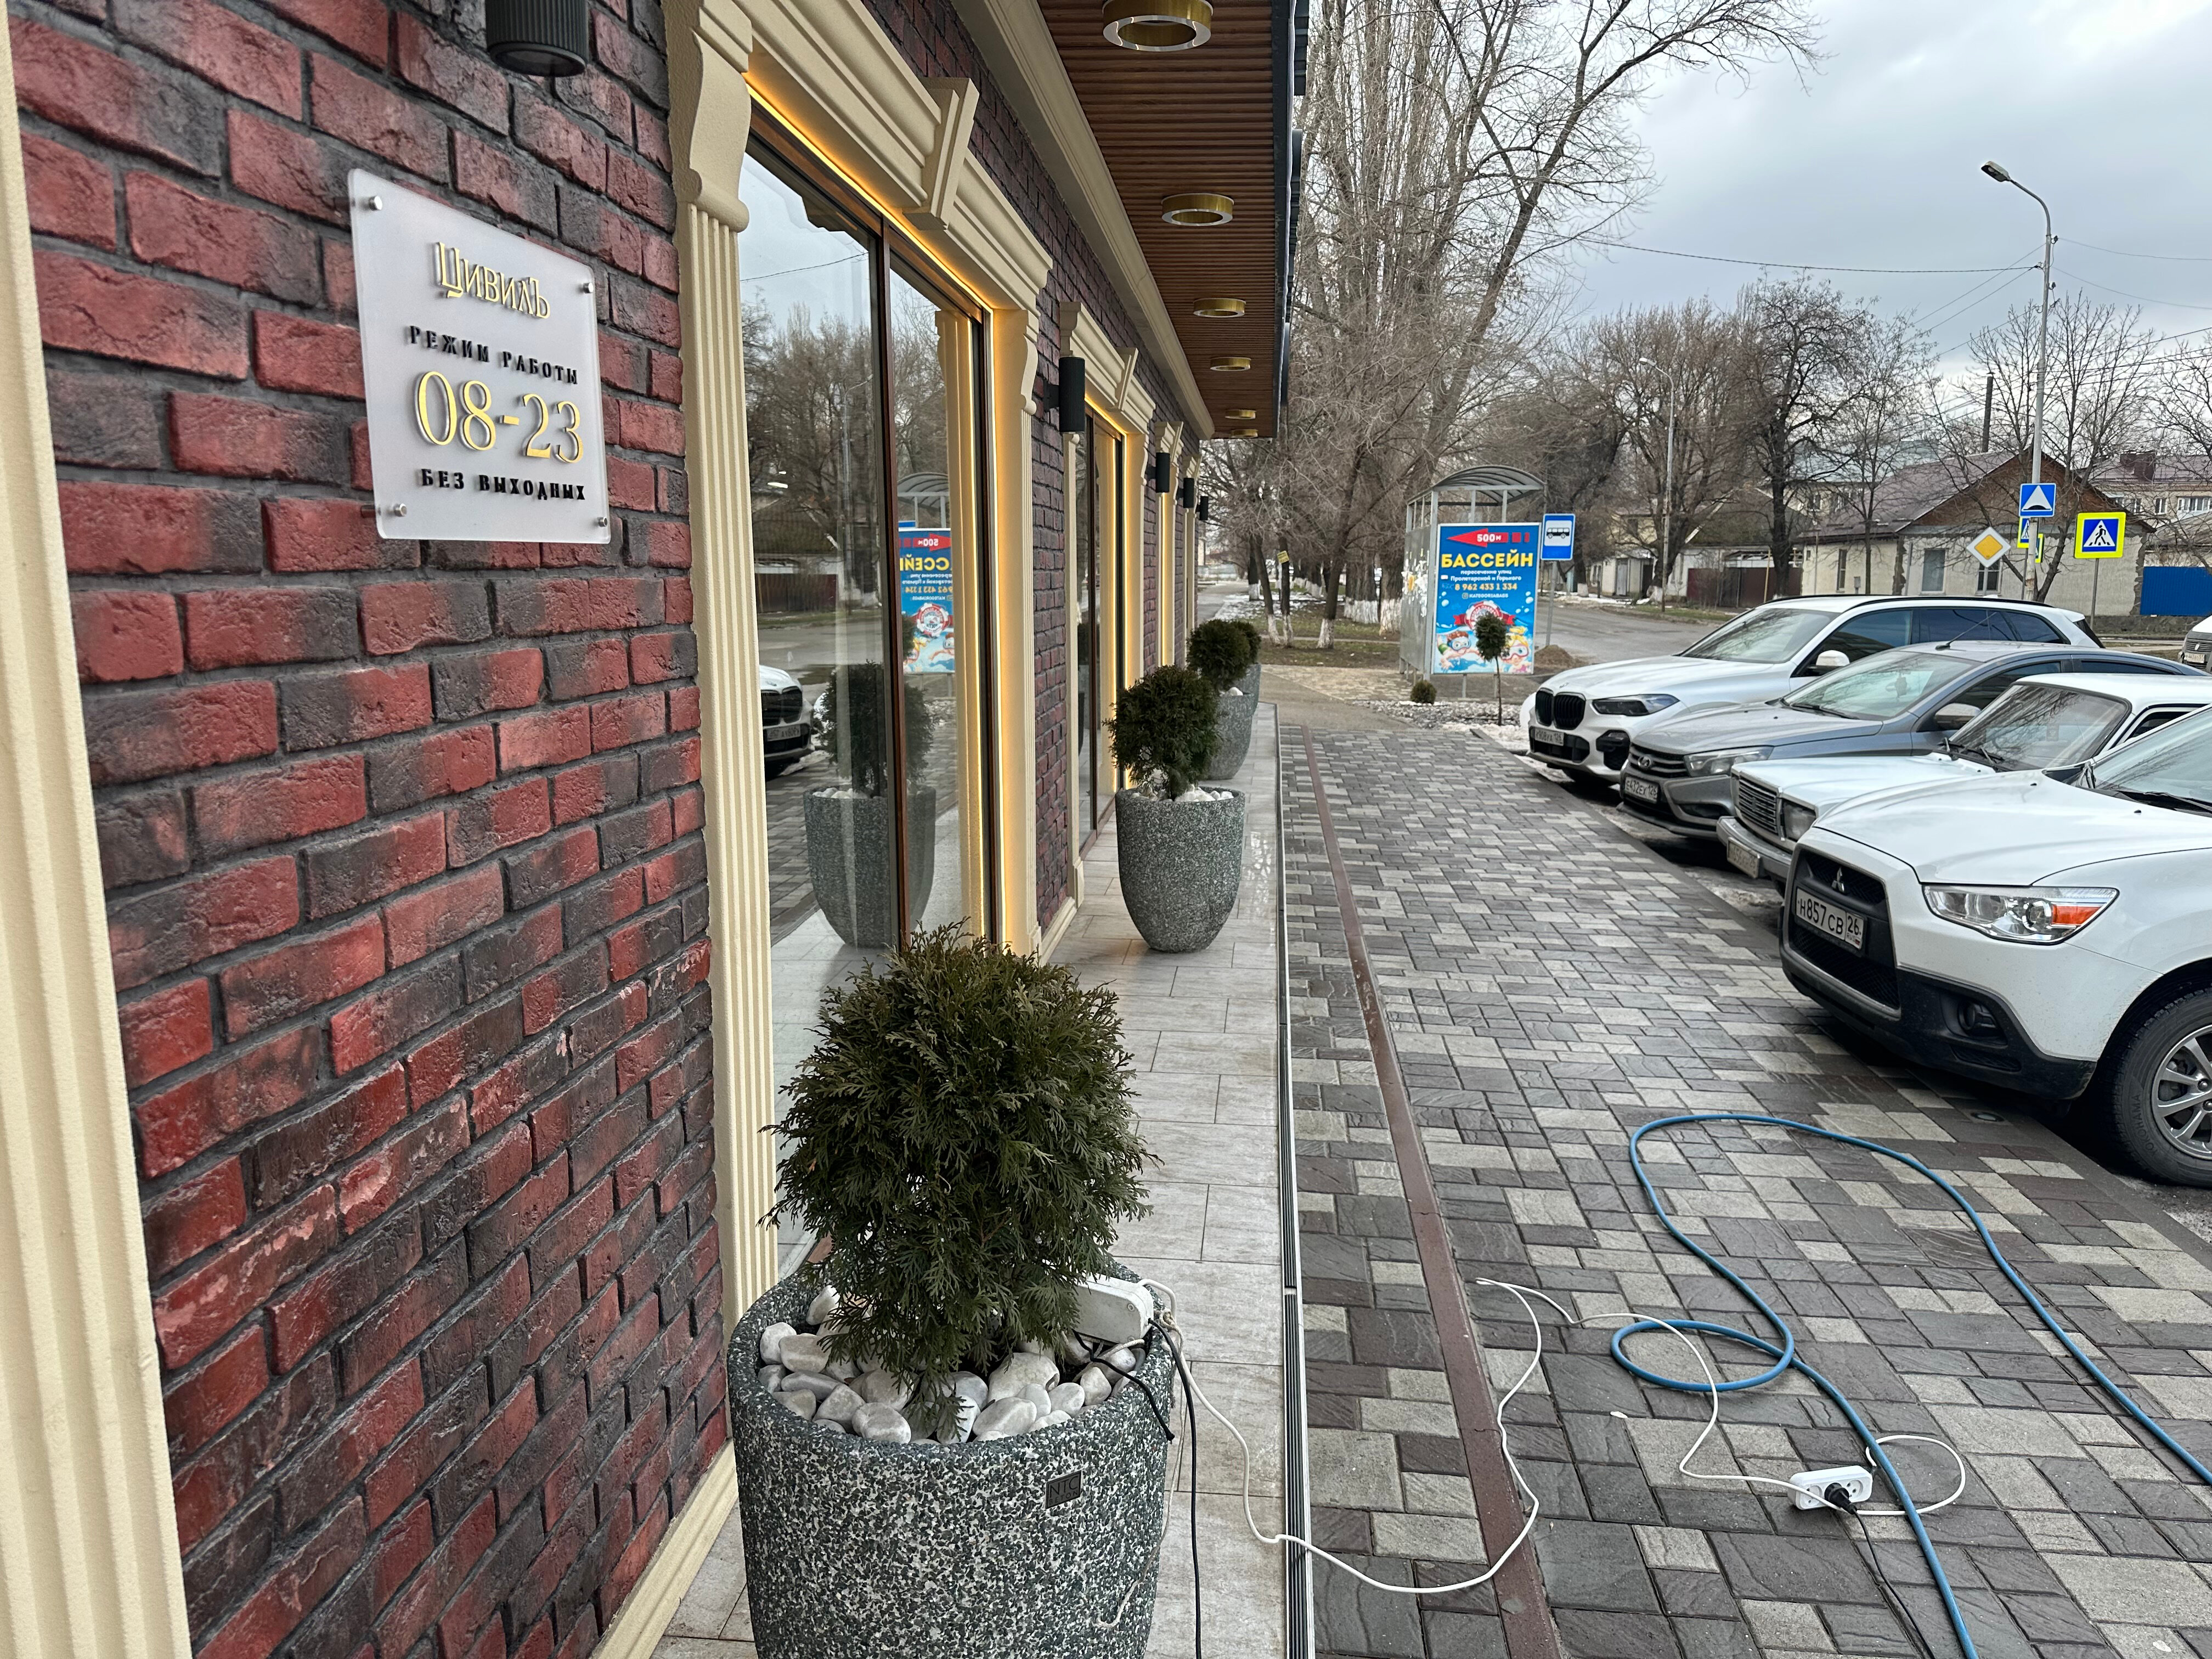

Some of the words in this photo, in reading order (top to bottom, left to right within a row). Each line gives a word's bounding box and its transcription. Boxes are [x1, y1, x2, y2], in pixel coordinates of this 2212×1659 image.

[410, 325, 490, 363] РЕЖИМ
[503, 351, 578, 385] РАБОТЫ
[415, 371, 584, 464] 08-23
[421, 469, 465, 489] БЕЗ
[478, 475, 585, 500] ВЫХОДНЫХ
[1441, 549, 1533, 568] БАССЕЙН
[1800, 898, 1844, 935] Н857СВ
[1847, 916, 1860, 935] 26
[2131, 1094, 2158, 1156] YOKOHAMA
[1049, 1476, 1079, 1498] NTC
[1049, 1489, 1079, 1505] BETON
